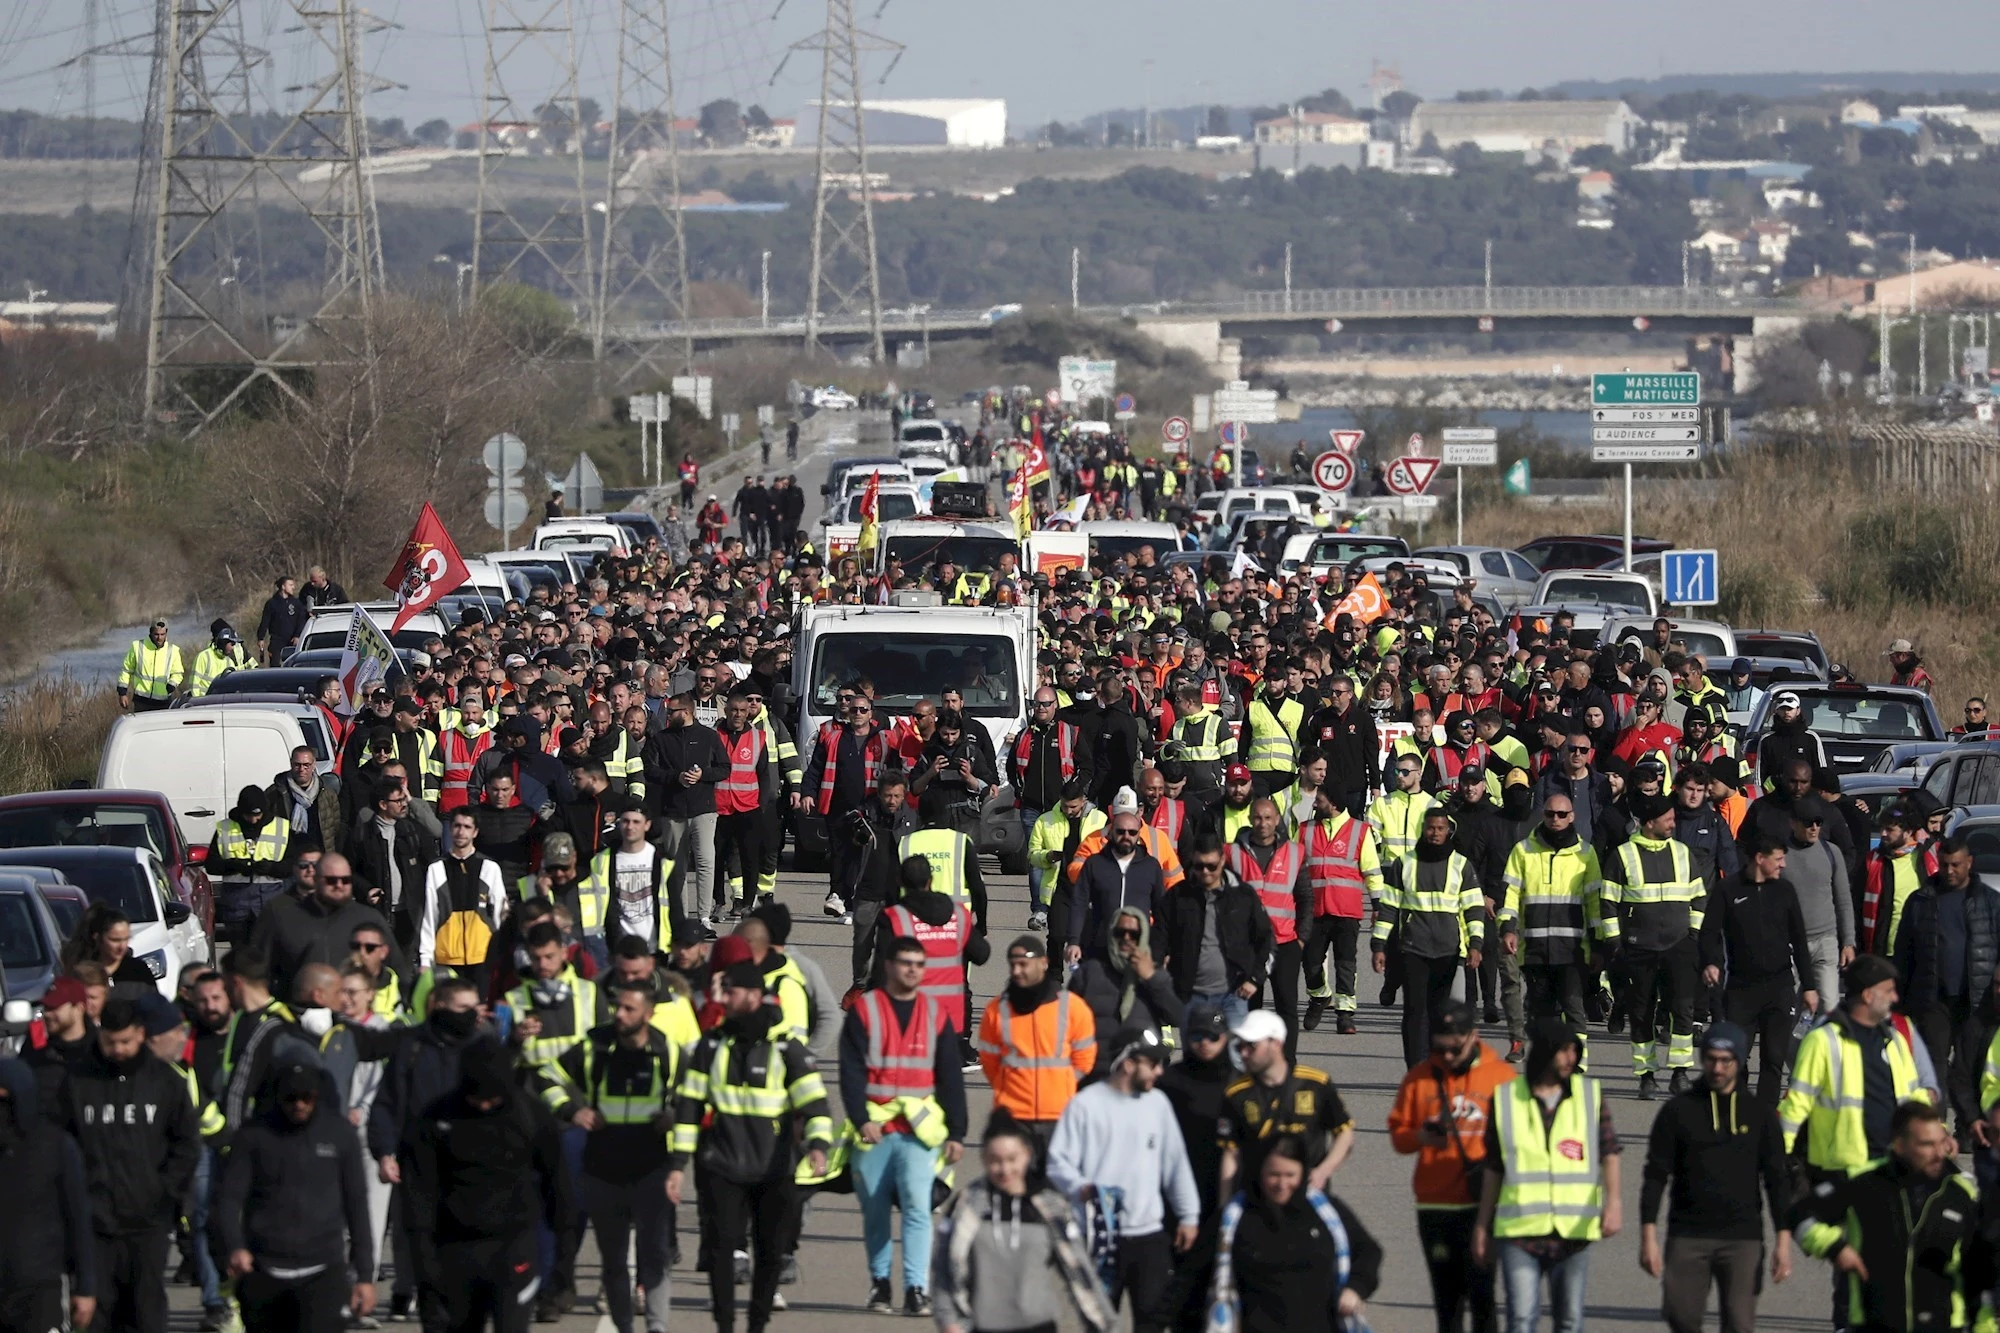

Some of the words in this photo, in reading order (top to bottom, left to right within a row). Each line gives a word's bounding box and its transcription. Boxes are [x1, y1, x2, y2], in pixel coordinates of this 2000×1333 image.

[1626, 377, 1694, 388] MARSEILLE
[1624, 390, 1694, 400] MARTIGUES
[1632, 411, 1653, 420] FOS
[1671, 411, 1694, 420] MER
[1596, 430, 1657, 439] L'AUDIENCE
[1322, 465, 1345, 480] 70
